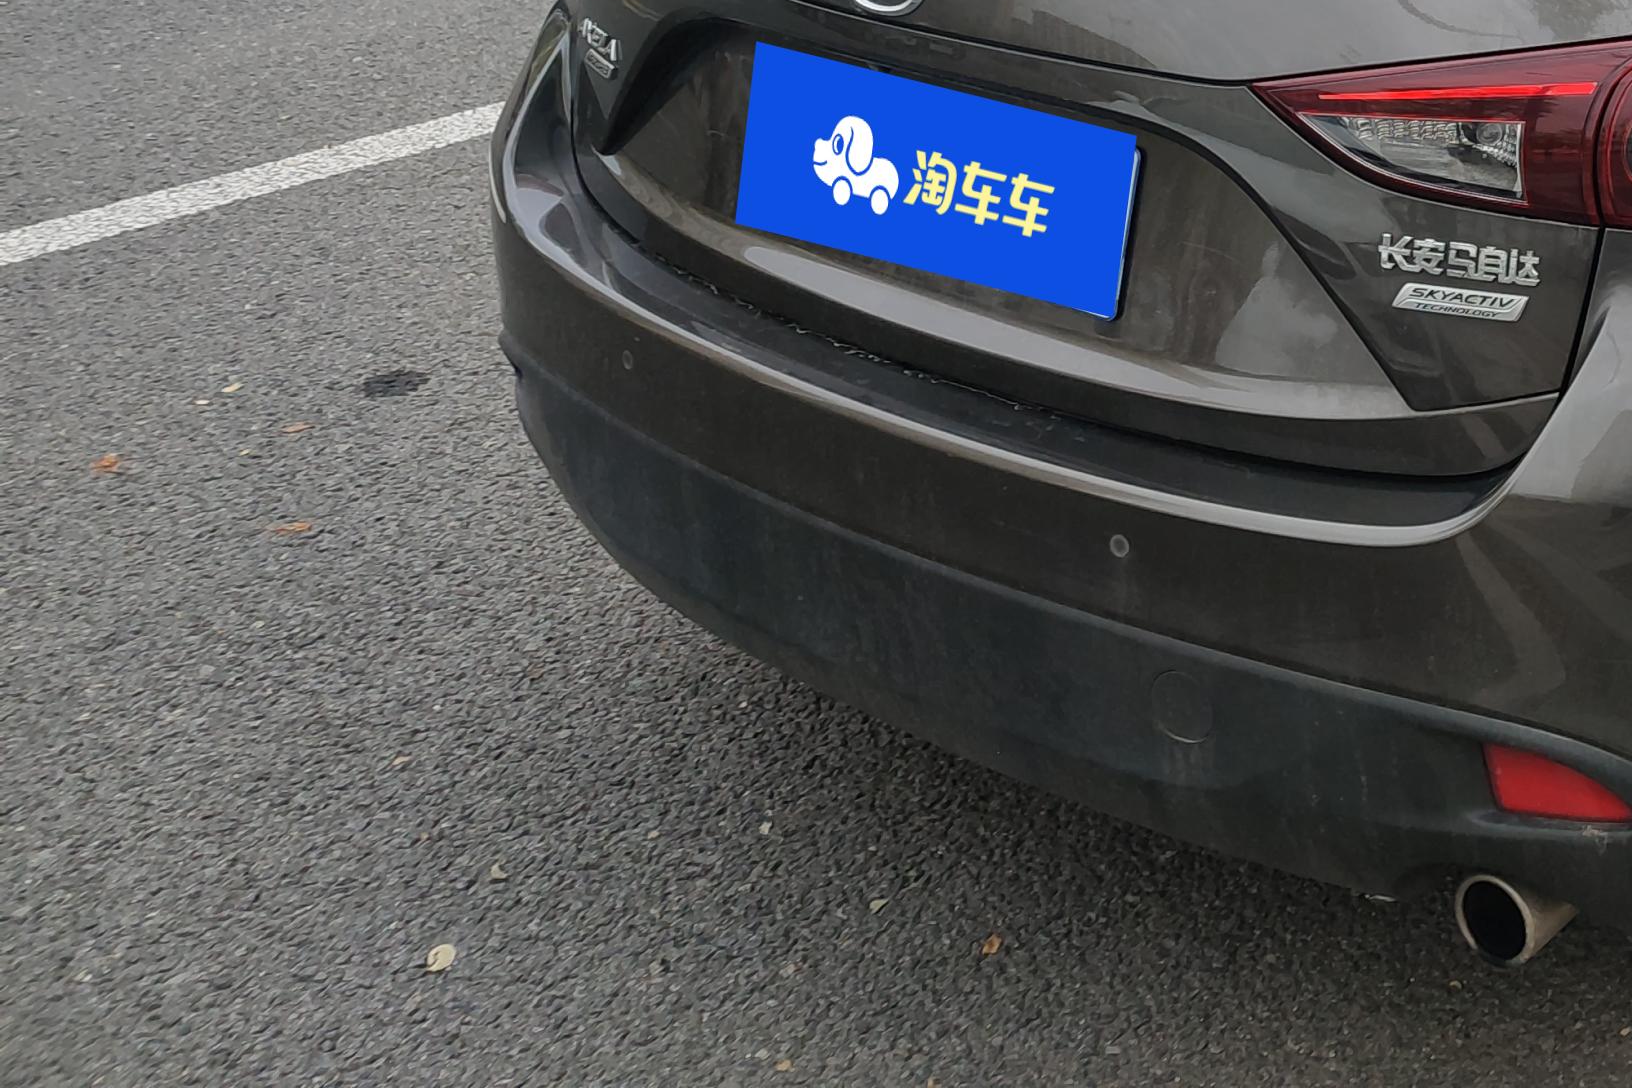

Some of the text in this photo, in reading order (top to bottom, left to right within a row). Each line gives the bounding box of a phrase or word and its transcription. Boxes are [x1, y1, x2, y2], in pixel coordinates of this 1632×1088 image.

[1378, 233, 1541, 287] 长安马自达
[1409, 287, 1515, 308] SKYACTIV
[1415, 302, 1500, 318] TECHNOLOGY
